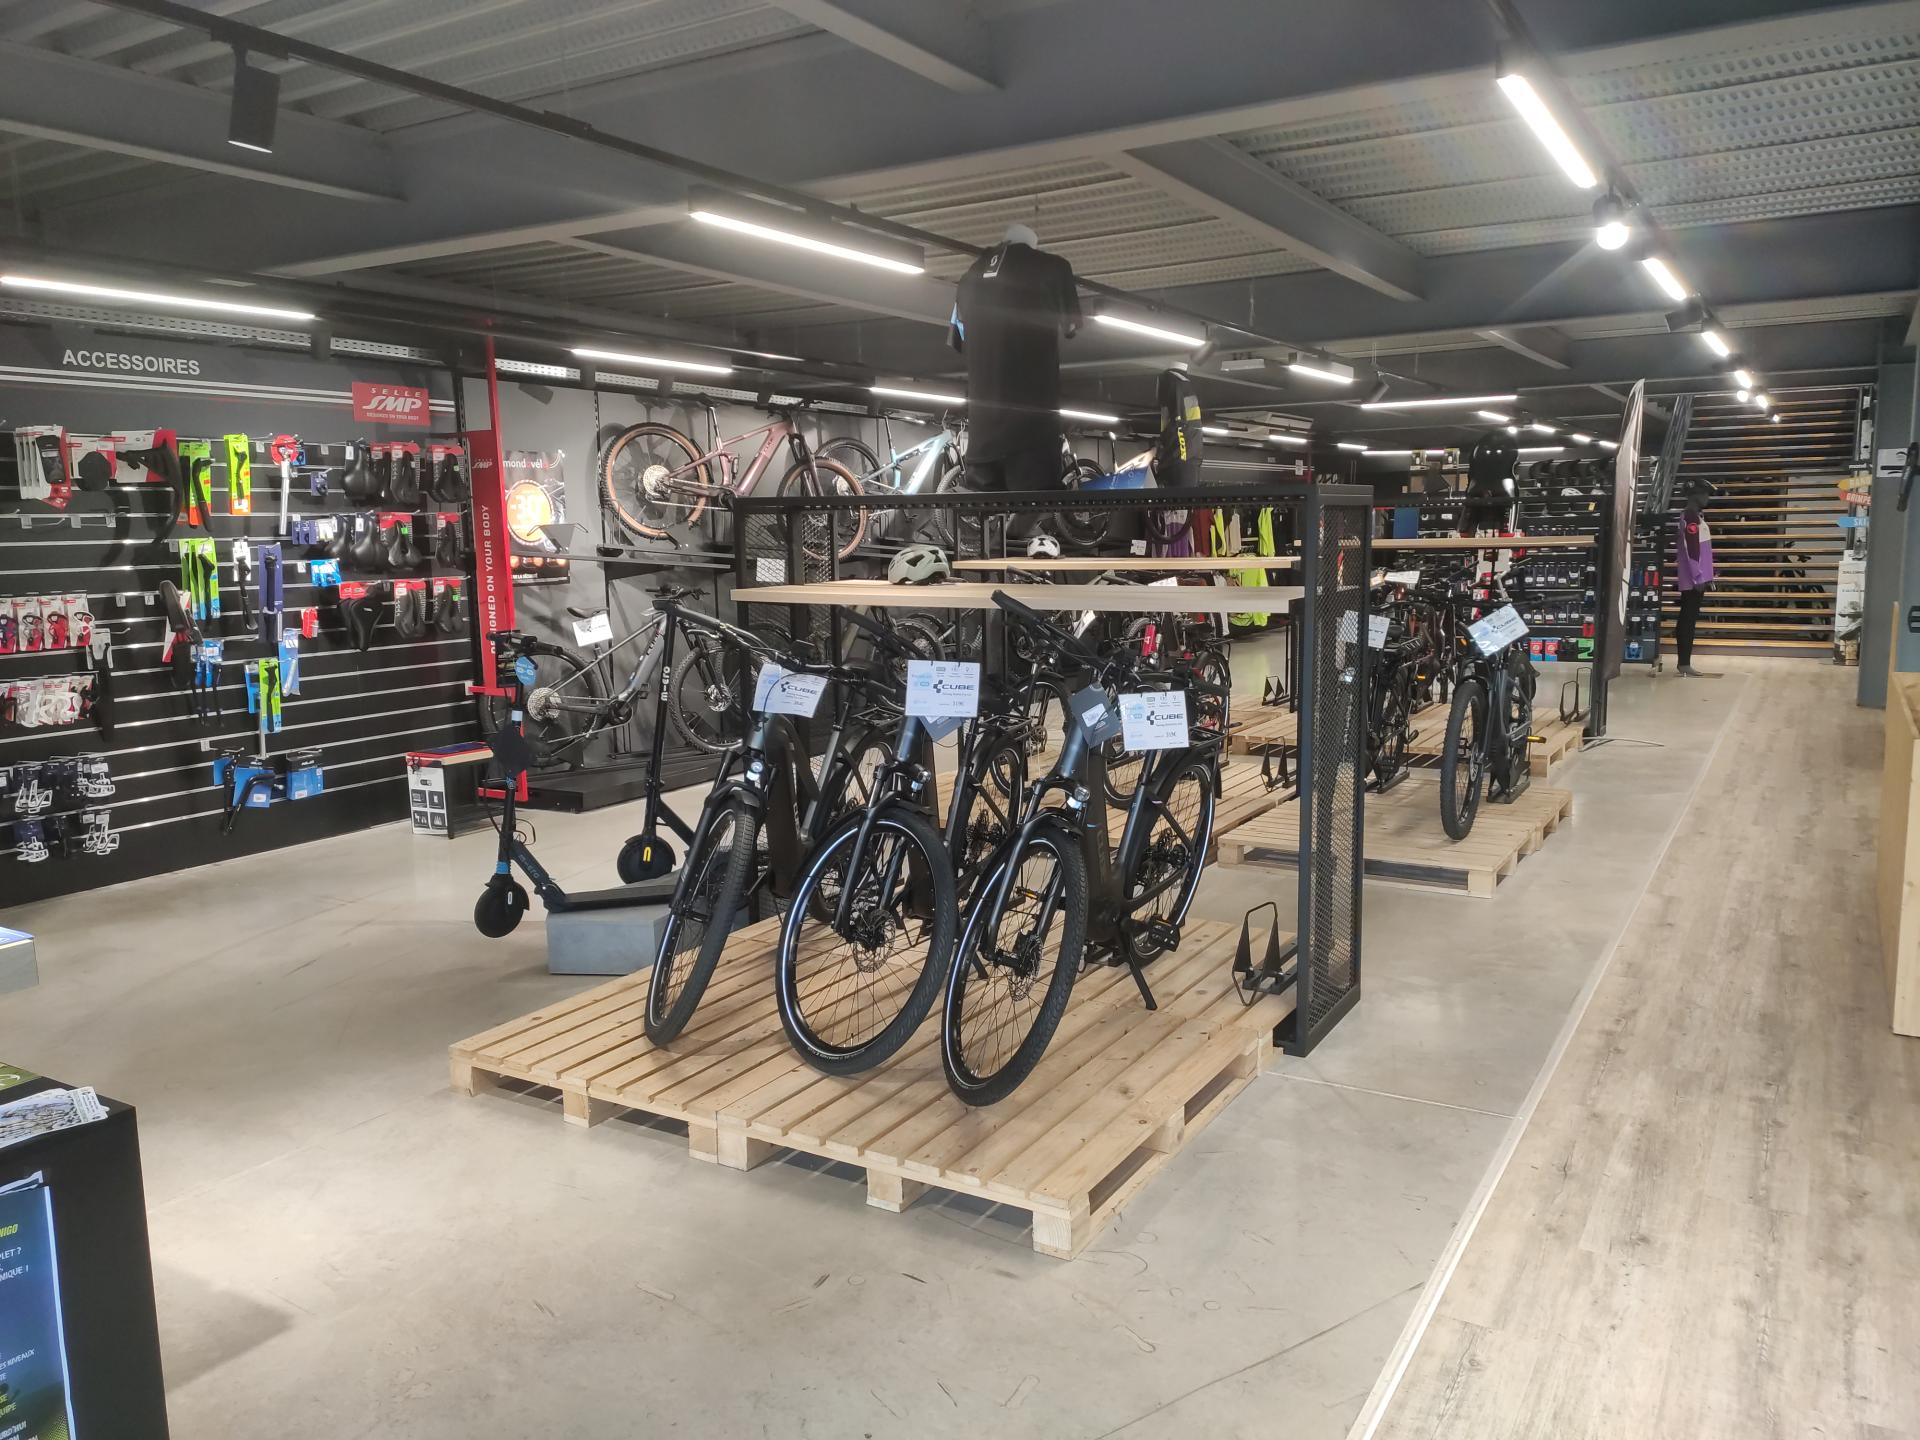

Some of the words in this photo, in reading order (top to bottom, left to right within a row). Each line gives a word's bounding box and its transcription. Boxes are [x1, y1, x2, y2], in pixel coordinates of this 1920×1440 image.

[62, 349, 200, 375] ACCESSOIRES
[371, 388, 421, 397] SELLE
[362, 395, 422, 413] SMP
[481, 504, 491, 537] BODY
[483, 540, 493, 572] YOUR
[486, 575, 495, 592] ON
[488, 596, 497, 654] DEIGNED
[1154, 713, 1184, 721] CUBE
